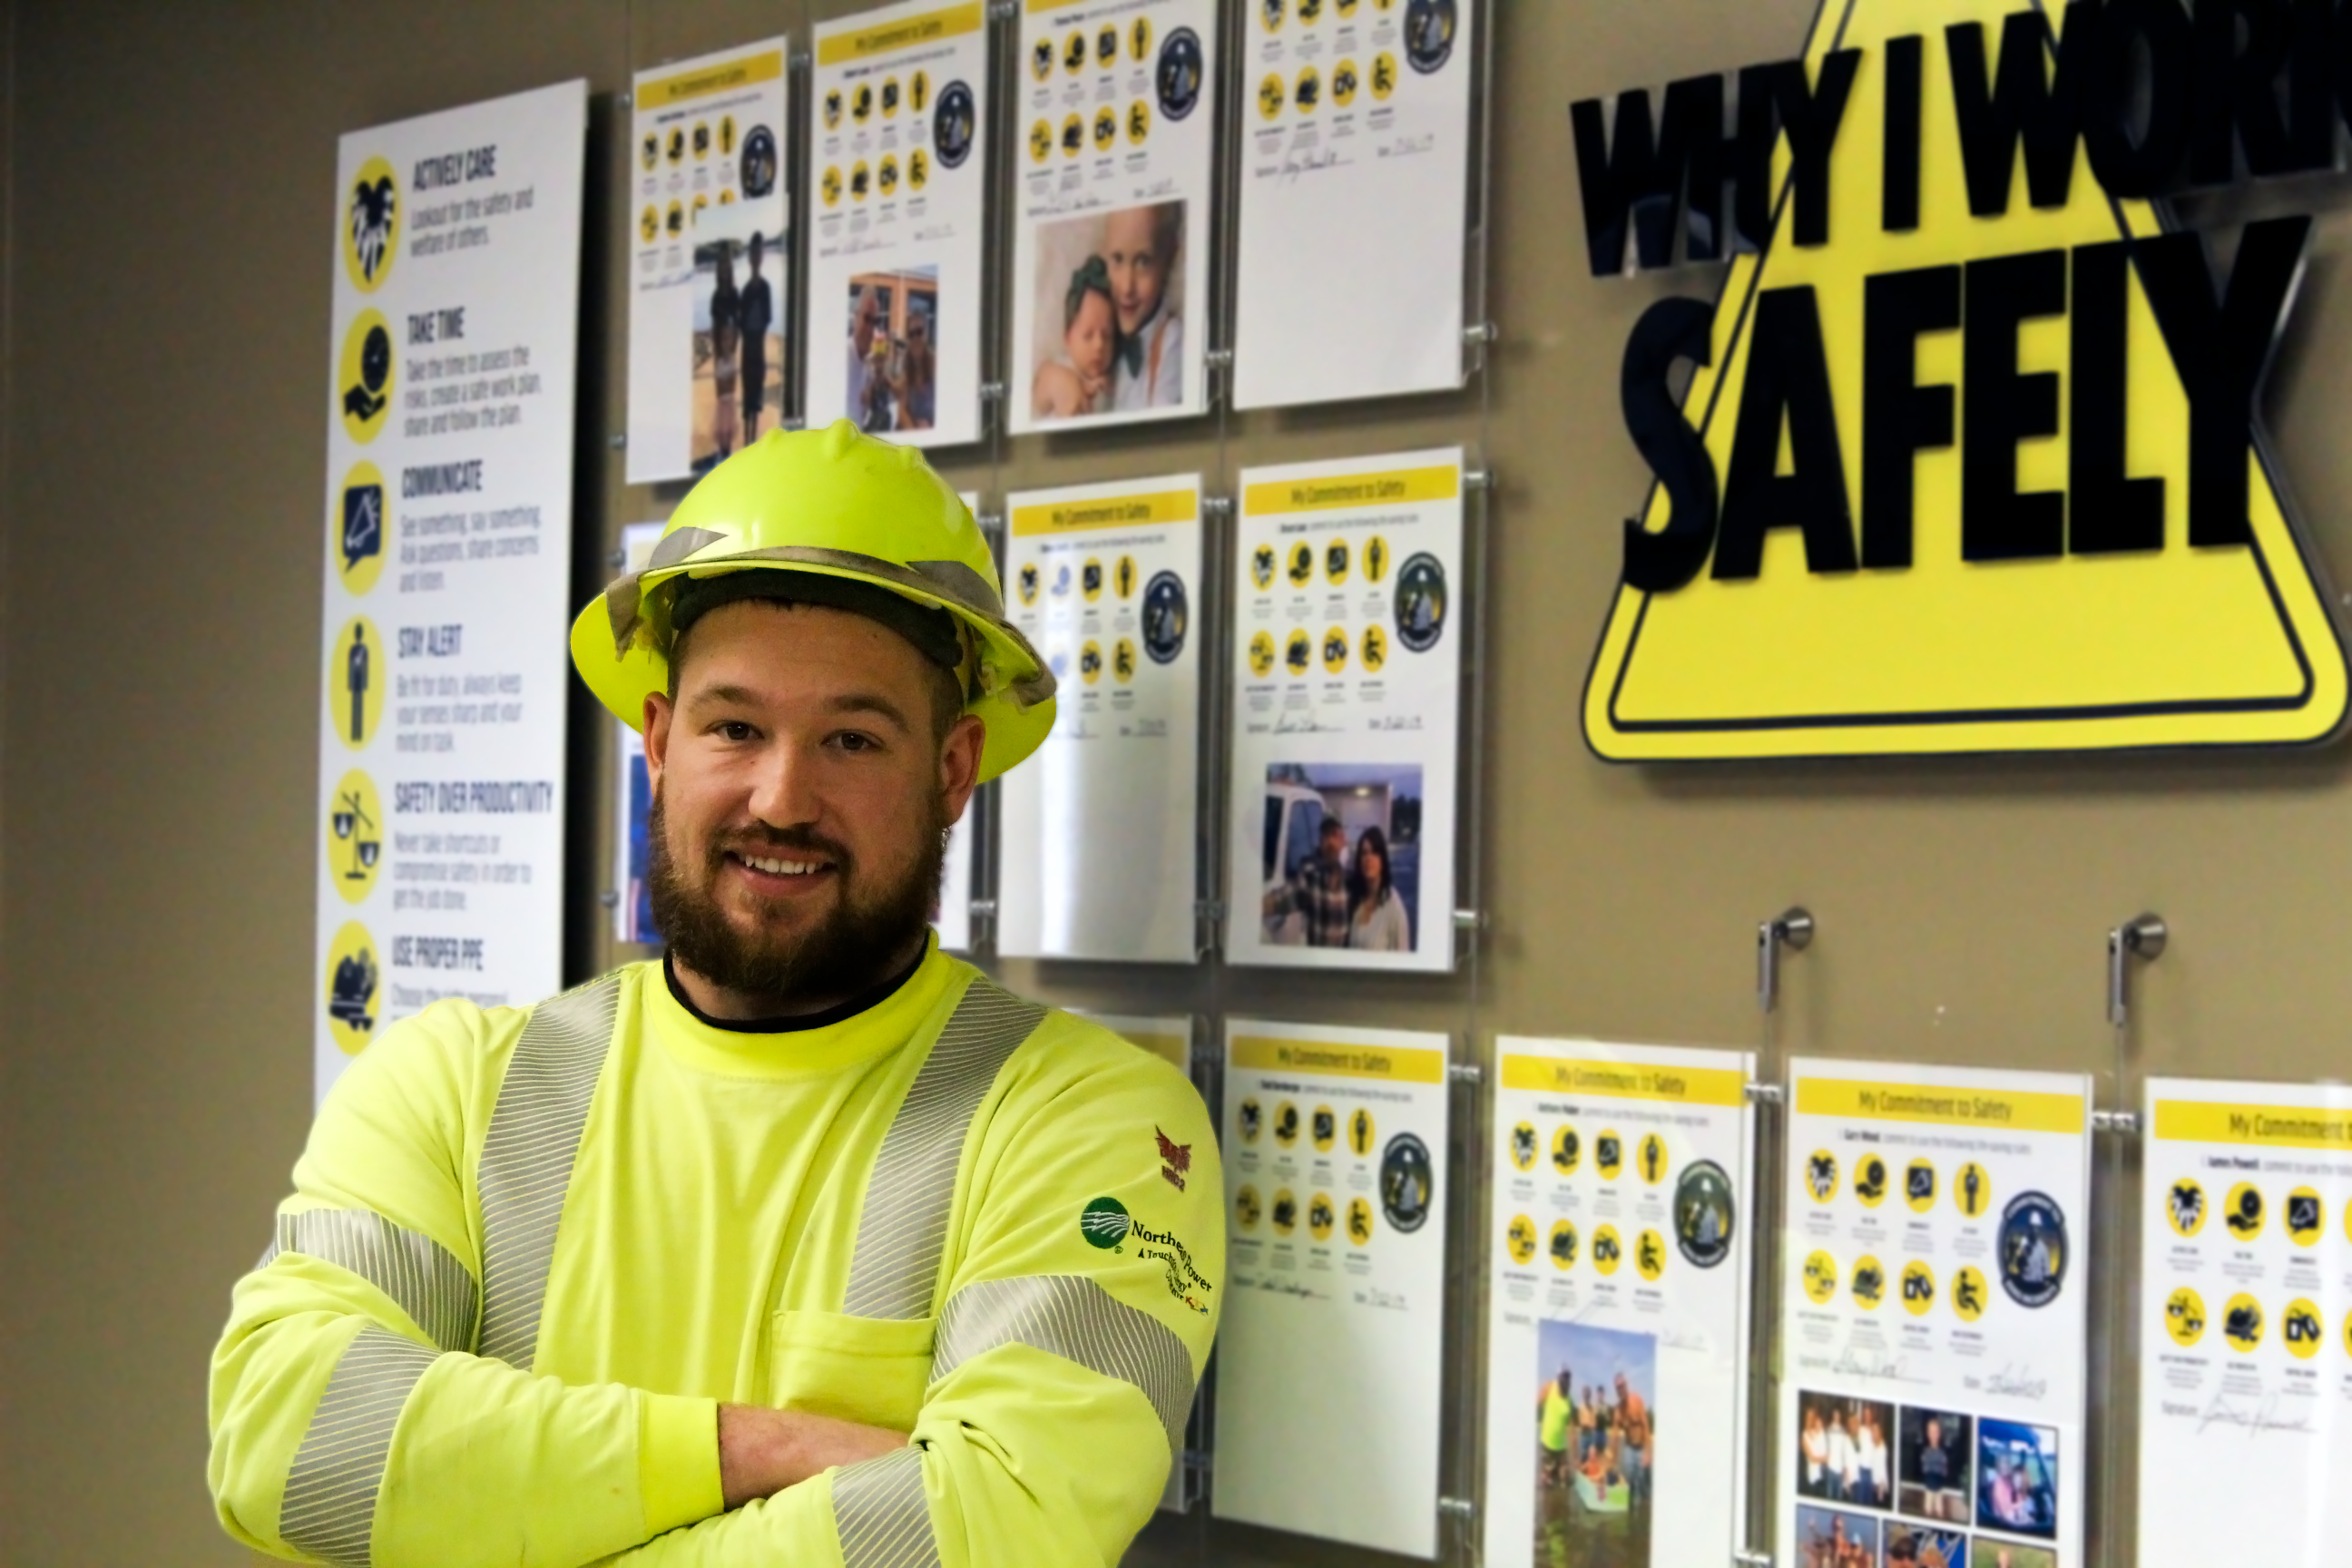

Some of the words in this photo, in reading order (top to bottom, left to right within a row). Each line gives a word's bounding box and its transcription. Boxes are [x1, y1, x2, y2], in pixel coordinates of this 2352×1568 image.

[413, 152, 463, 191] ACTIVELY
[466, 144, 496, 181] CARE
[1571, 47, 1863, 277] WHY
[1885, 34, 1924, 233] I
[407, 311, 435, 346] TAKE
[438, 306, 465, 340] TIME
[1621, 214, 2314, 596] SAFELY
[402, 459, 482, 498] COMMUNICATE
[1291, 488, 1305, 505] My
[1308, 484, 1363, 504] Commitment
[1366, 483, 1375, 499] to
[1377, 479, 1406, 497] Safety
[398, 626, 424, 658] STAY
[427, 623, 462, 657] ALERT
[395, 781, 435, 812] SAFETY
[438, 781, 466, 812] OVER
[470, 780, 553, 813] PRODUCTIVITY
[392, 935, 412, 966] USE
[416, 936, 458, 969] PROPER
[461, 938, 483, 971] PPE
[1278, 1047, 1290, 1063] My
[1293, 1047, 1348, 1071] Commitment
[1350, 1054, 1359, 1071] to
[1362, 1053, 1391, 1073] Safety
[1555, 1066, 1570, 1084] My
[1573, 1069, 1636, 1092] Commitment
[1639, 1073, 1651, 1092] to
[1652, 1074, 1685, 1095] Safety
[1858, 1091, 1876, 1111] My
[1879, 1093, 1954, 1116] Commitment
[1956, 1099, 1970, 1118] to
[1972, 1097, 2011, 1121] Safety
[2230, 1113, 2249, 1134] My
[2254, 1116, 2342, 1141] Commitment
[1138, 1248, 1144, 1259] A
[1183, 1254, 1212, 1292] Power
